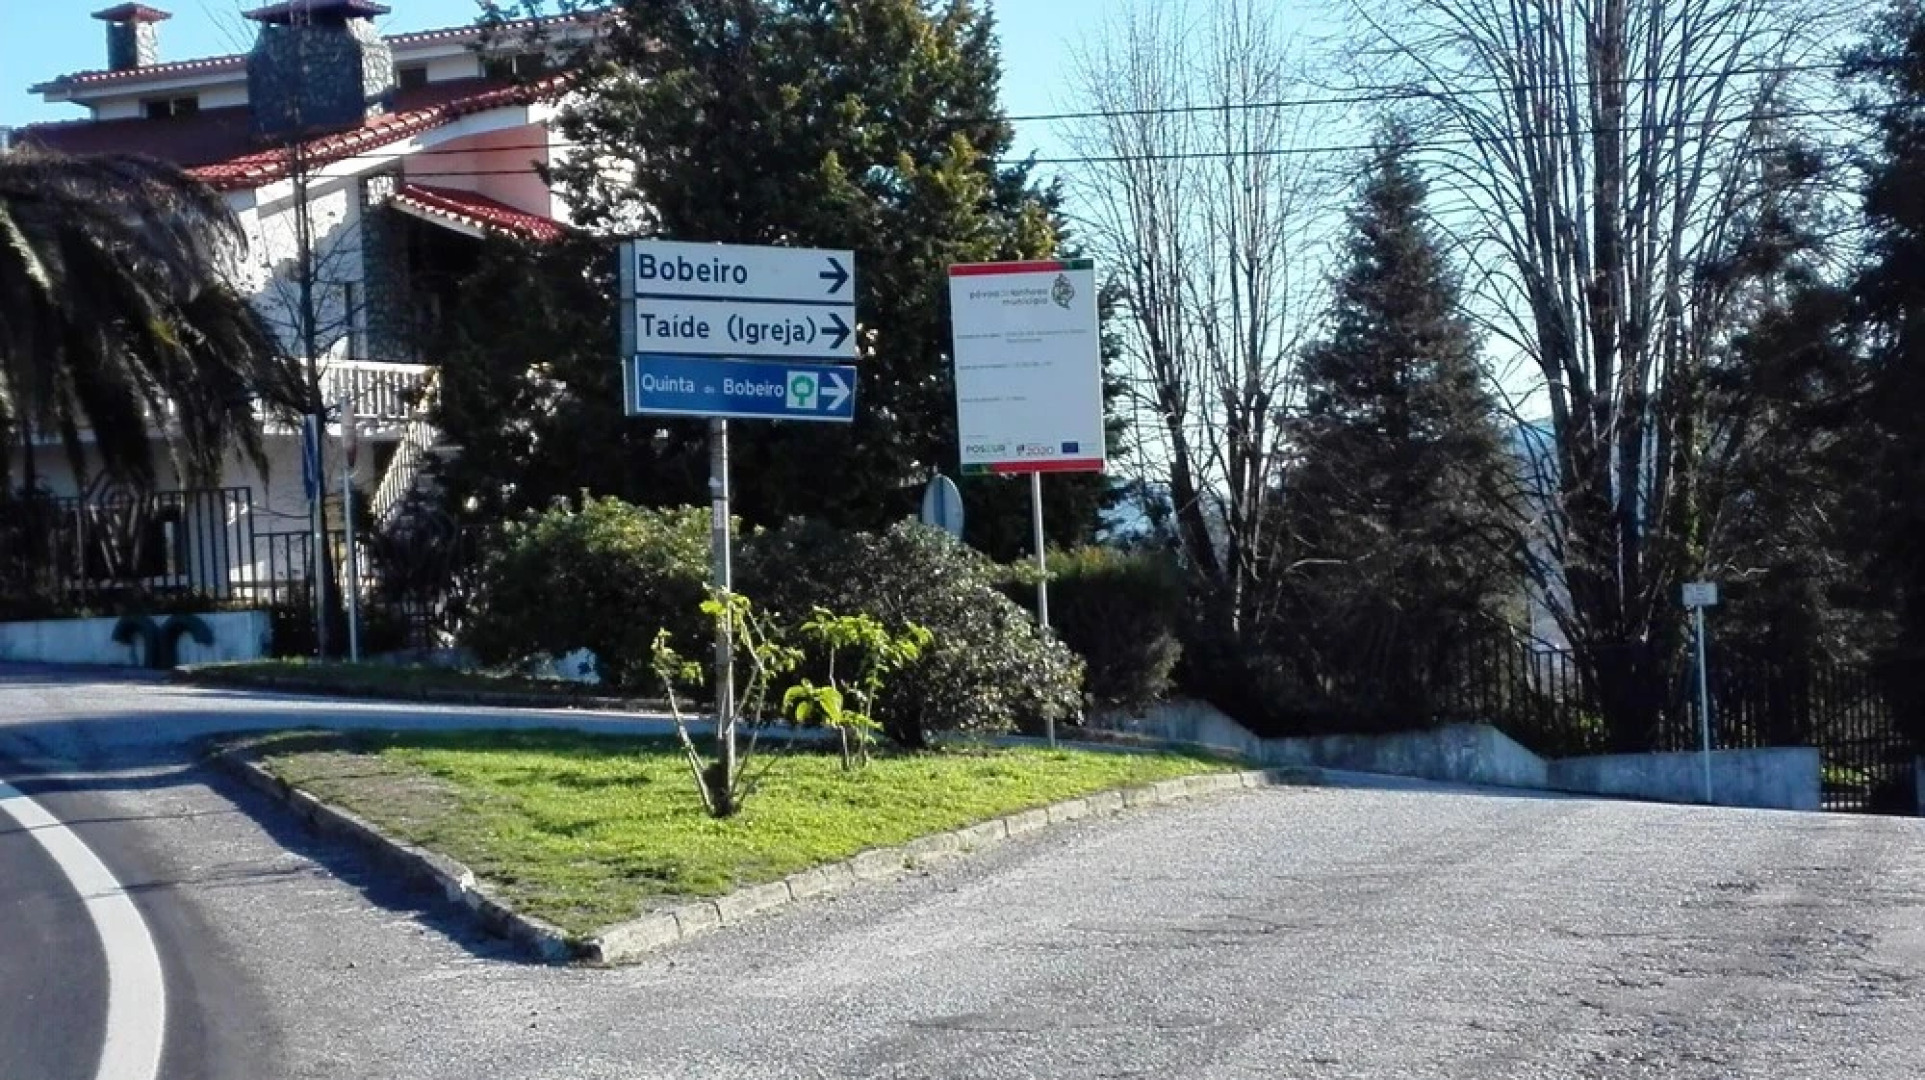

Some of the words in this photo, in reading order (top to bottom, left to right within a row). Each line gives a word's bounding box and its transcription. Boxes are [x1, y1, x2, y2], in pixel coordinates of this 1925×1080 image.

[639, 254, 748, 284] Bobeiro
[640, 313, 710, 338] Taíde
[727, 313, 816, 345] (Igreja)
[641, 373, 695, 394] Quinta
[723, 378, 784, 398] Bobeiro
